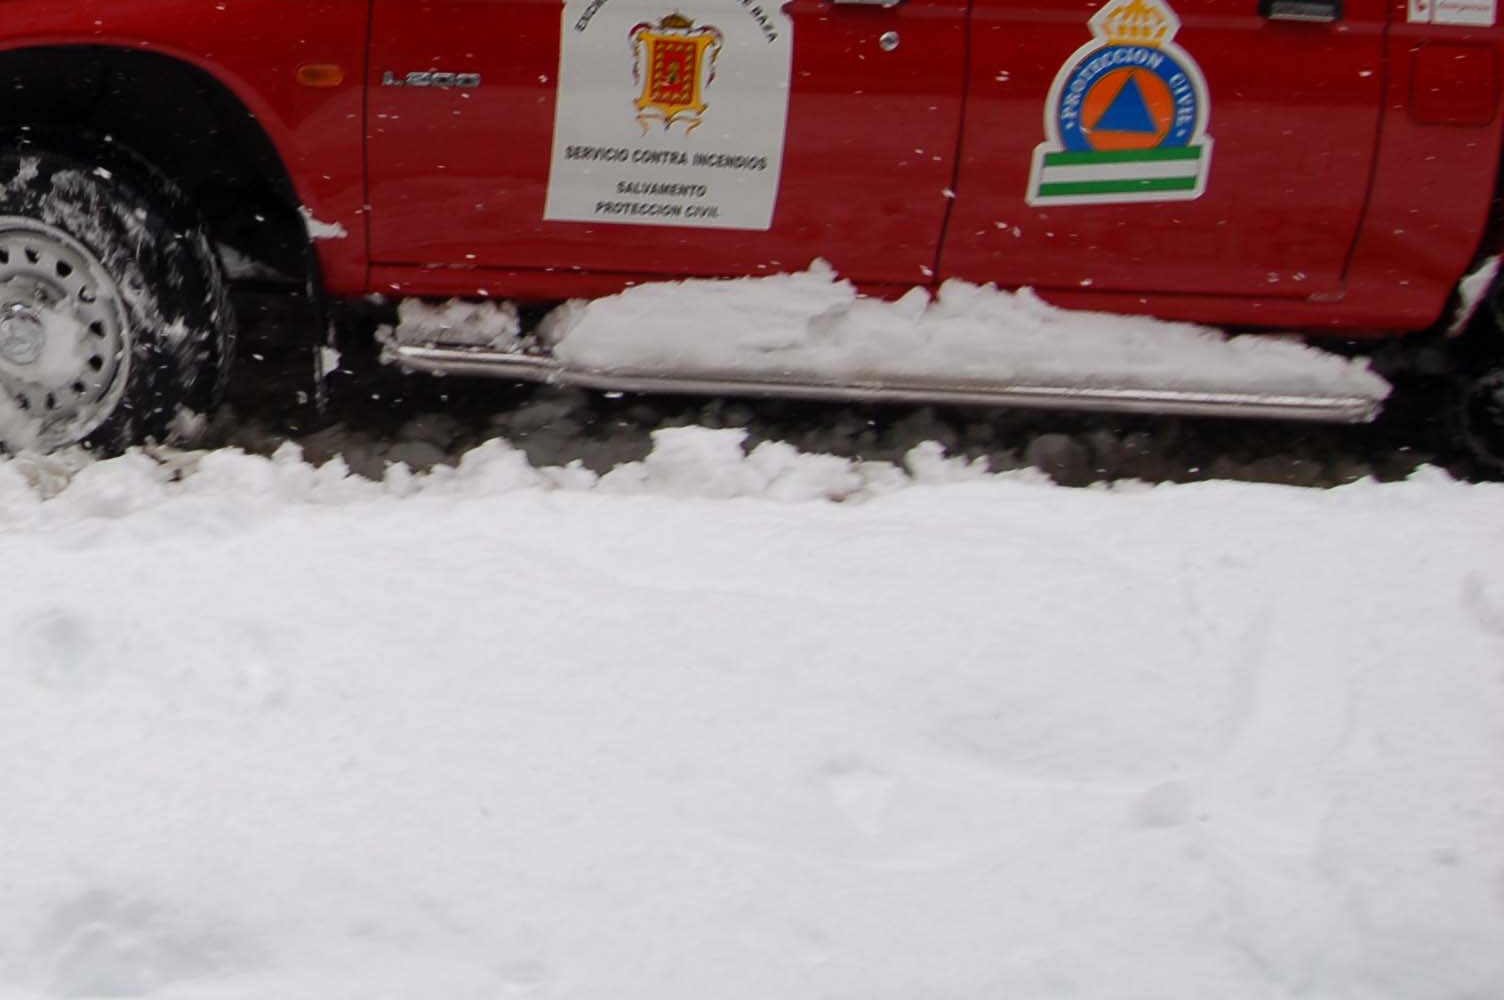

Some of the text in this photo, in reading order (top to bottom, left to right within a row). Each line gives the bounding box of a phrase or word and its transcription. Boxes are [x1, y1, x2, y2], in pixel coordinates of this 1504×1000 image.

[1061, 47, 1194, 126] PROTECCION CIVIL
[564, 145, 769, 172] SERVICIO CONTRA INCENDIOS
[616, 180, 708, 198] SALVAMENTO
[594, 201, 720, 219] PROTECCION CIVIL
